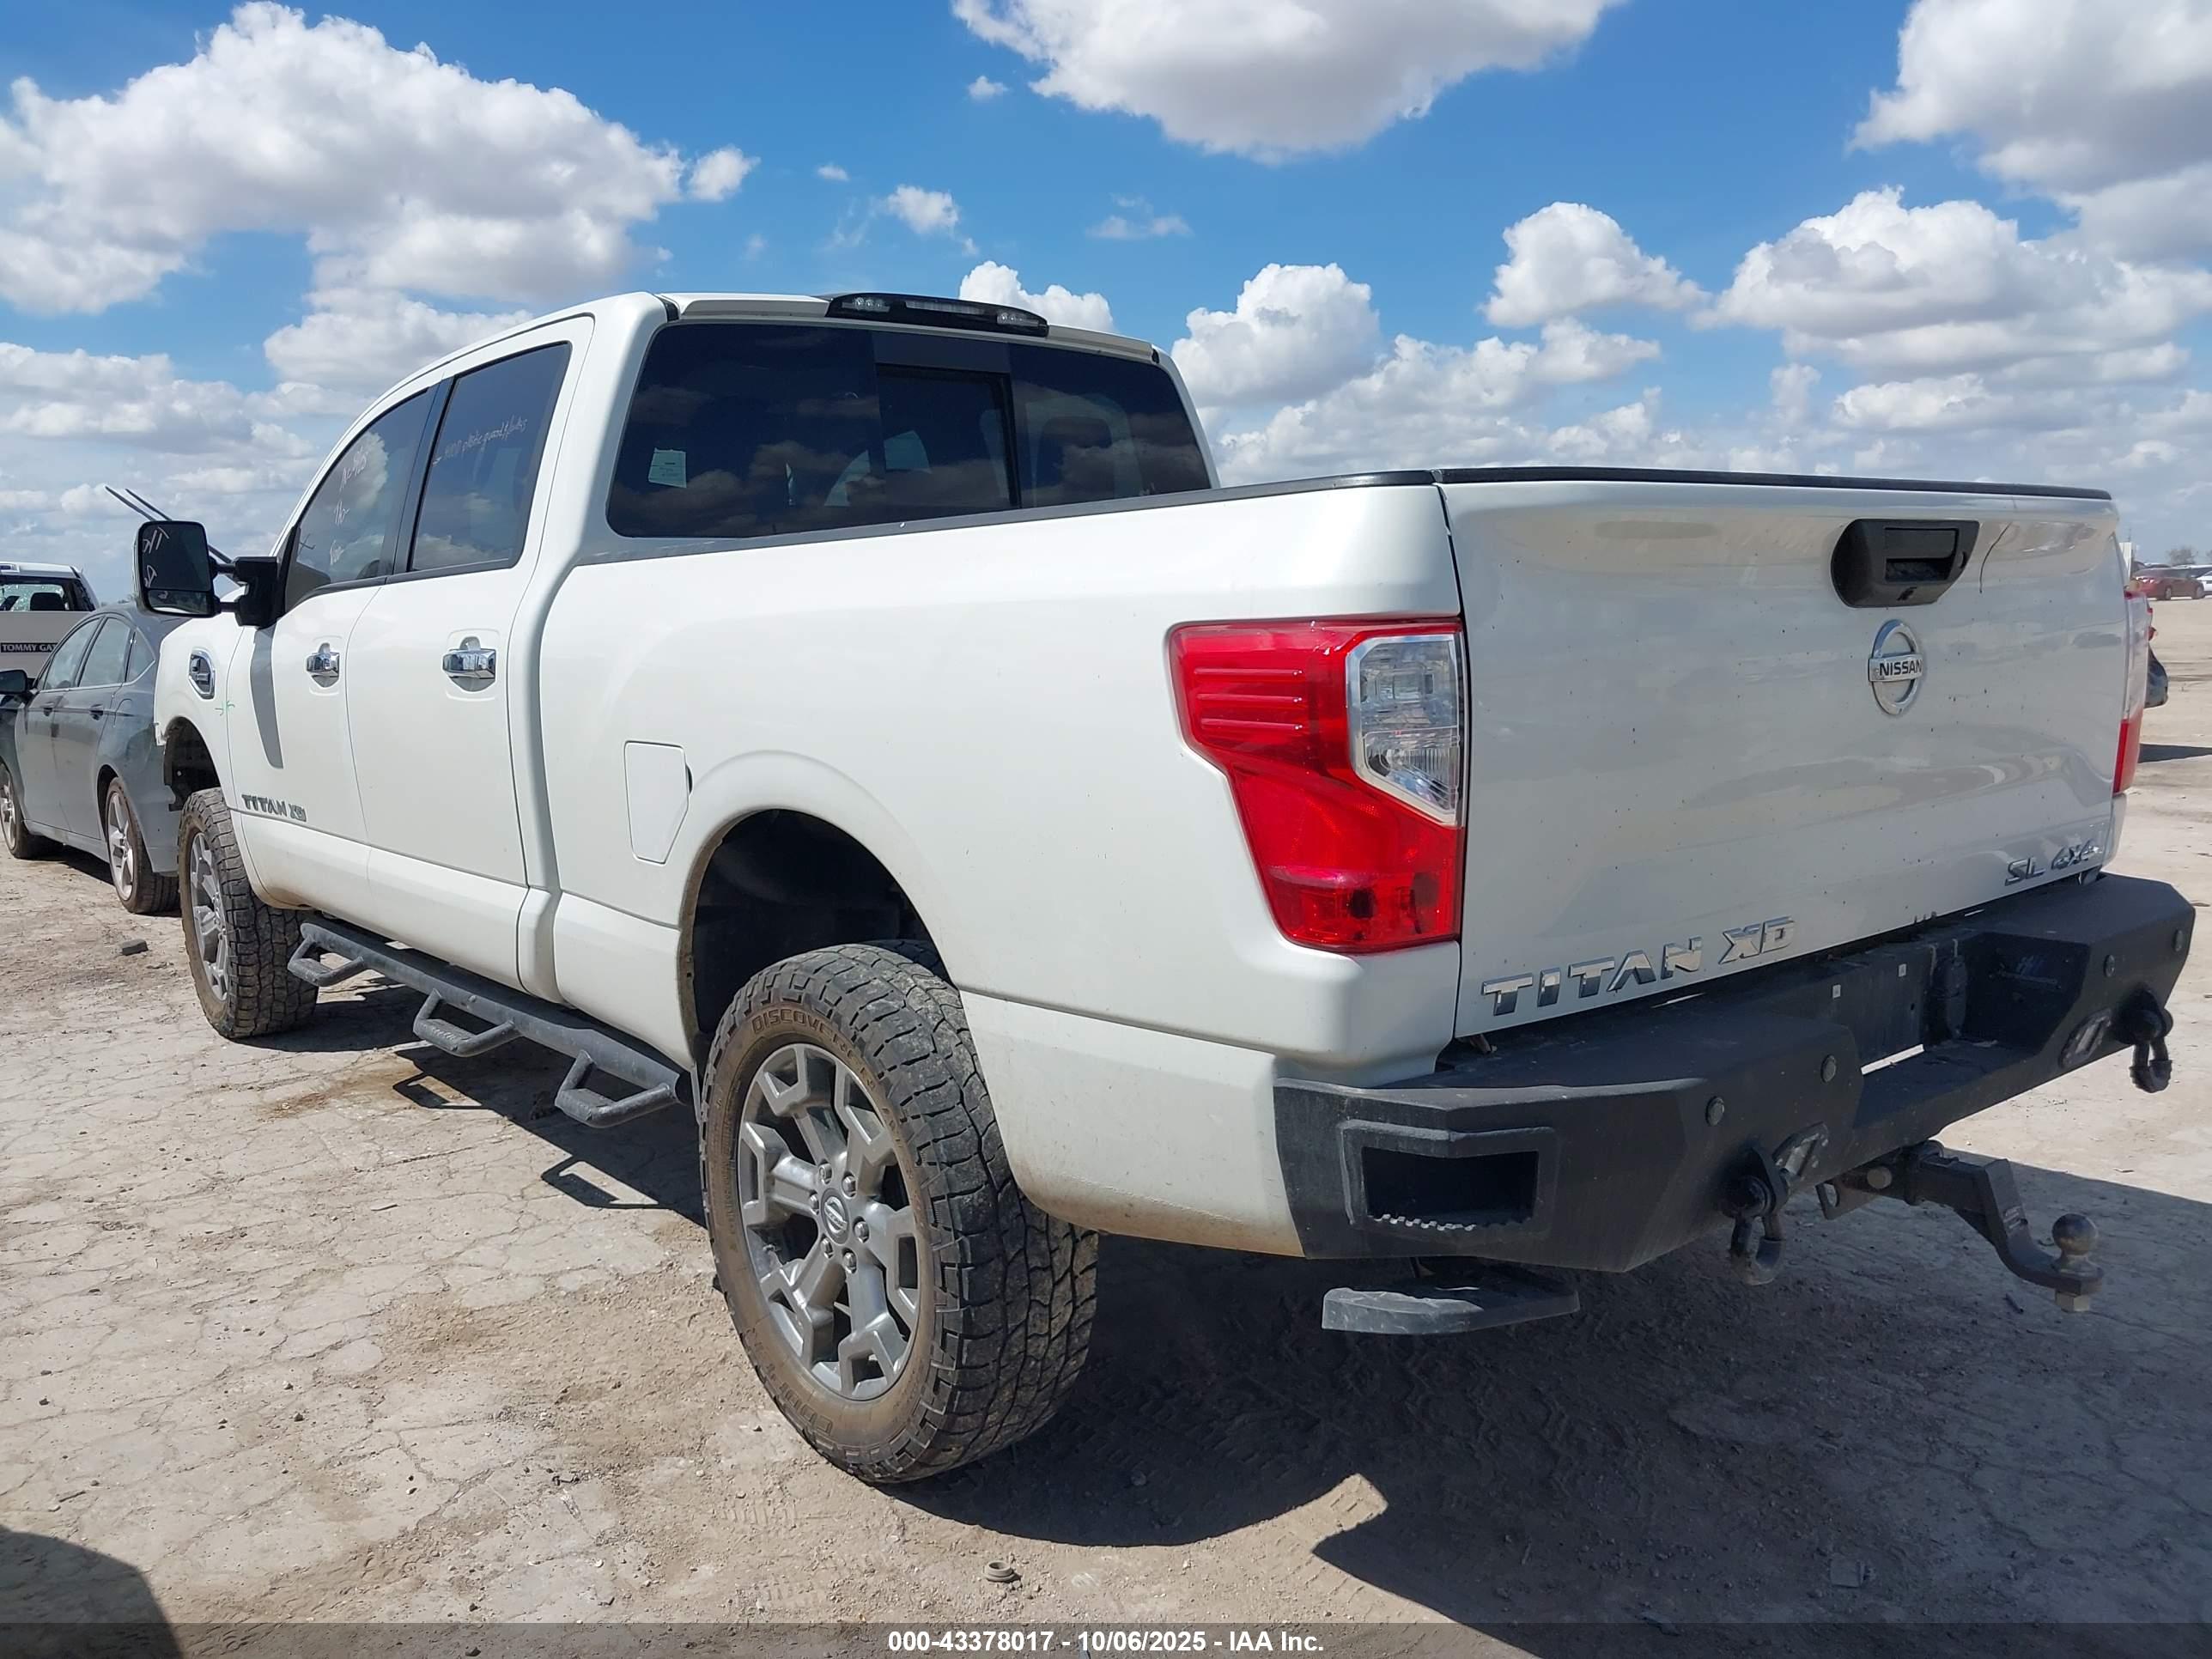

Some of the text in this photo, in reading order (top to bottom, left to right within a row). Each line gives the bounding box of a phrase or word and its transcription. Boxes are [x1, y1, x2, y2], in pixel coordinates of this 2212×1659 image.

[1879, 659, 1922, 676] NISSAN
[241, 793, 288, 817] TITAN
[2004, 858, 2046, 886] SL
[1481, 915, 1796, 1016] TITAN XD
